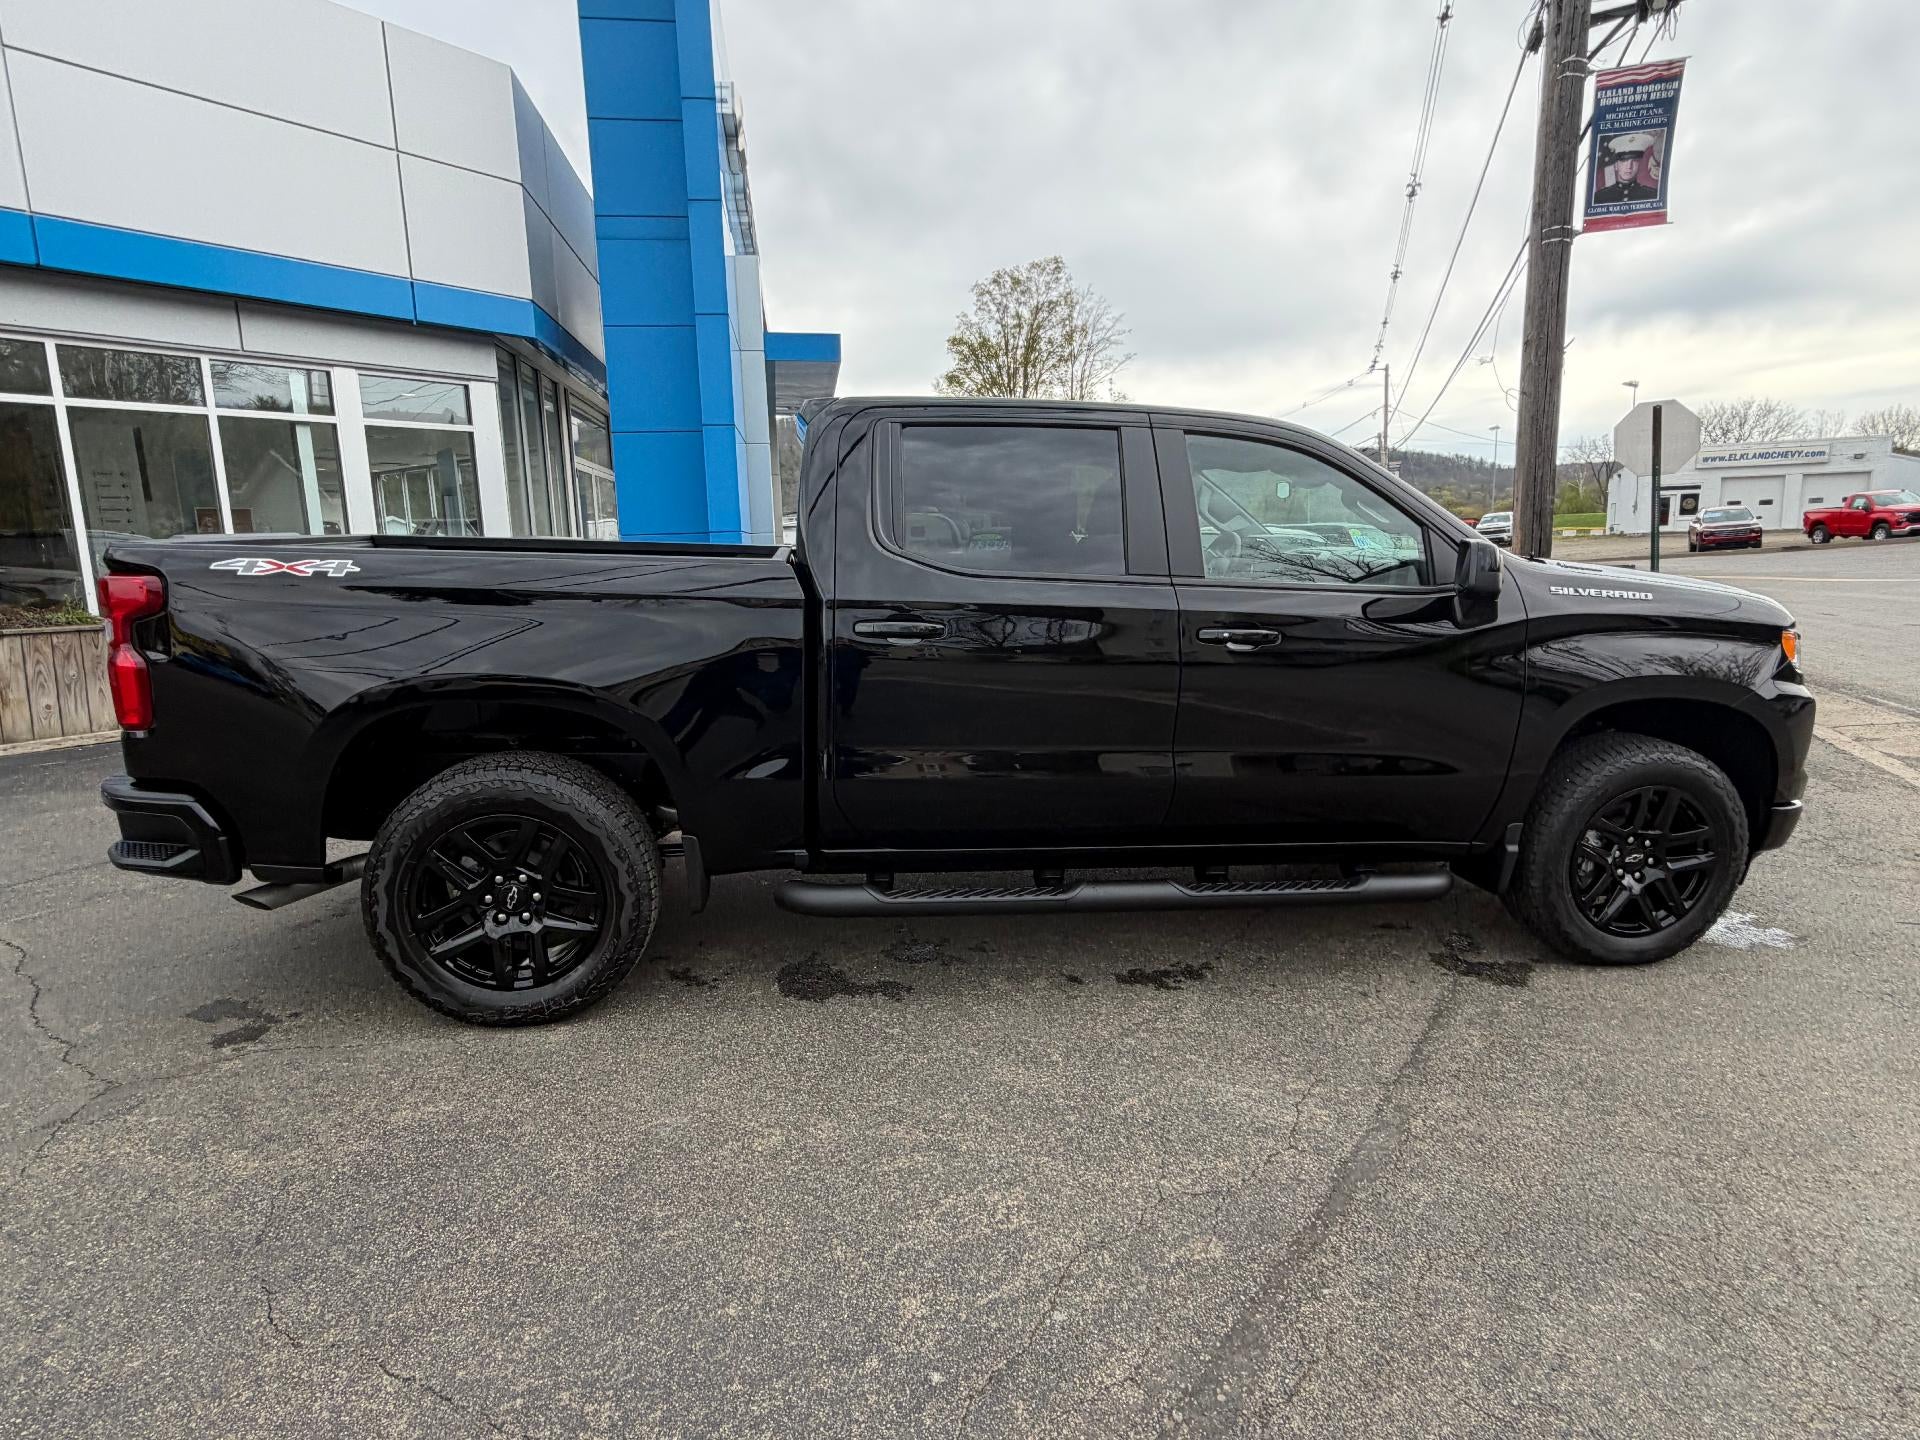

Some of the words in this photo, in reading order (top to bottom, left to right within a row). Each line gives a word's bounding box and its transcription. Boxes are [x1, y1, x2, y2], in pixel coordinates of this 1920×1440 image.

[1636, 81, 1679, 94] BOROUGH
[1600, 93, 1648, 106] HOMETOWN
[1650, 90, 1674, 100] HERO
[1605, 111, 1638, 120] MICHAEL
[1639, 108, 1664, 116] PLANK
[1600, 122, 1612, 130] U.S.
[1614, 119, 1642, 128] MARINE
[1643, 117, 1668, 126] CORPS
[1702, 450, 1826, 463] www.ELKLANDCHEVY.com
[1549, 586, 1654, 600] SILVERADO
